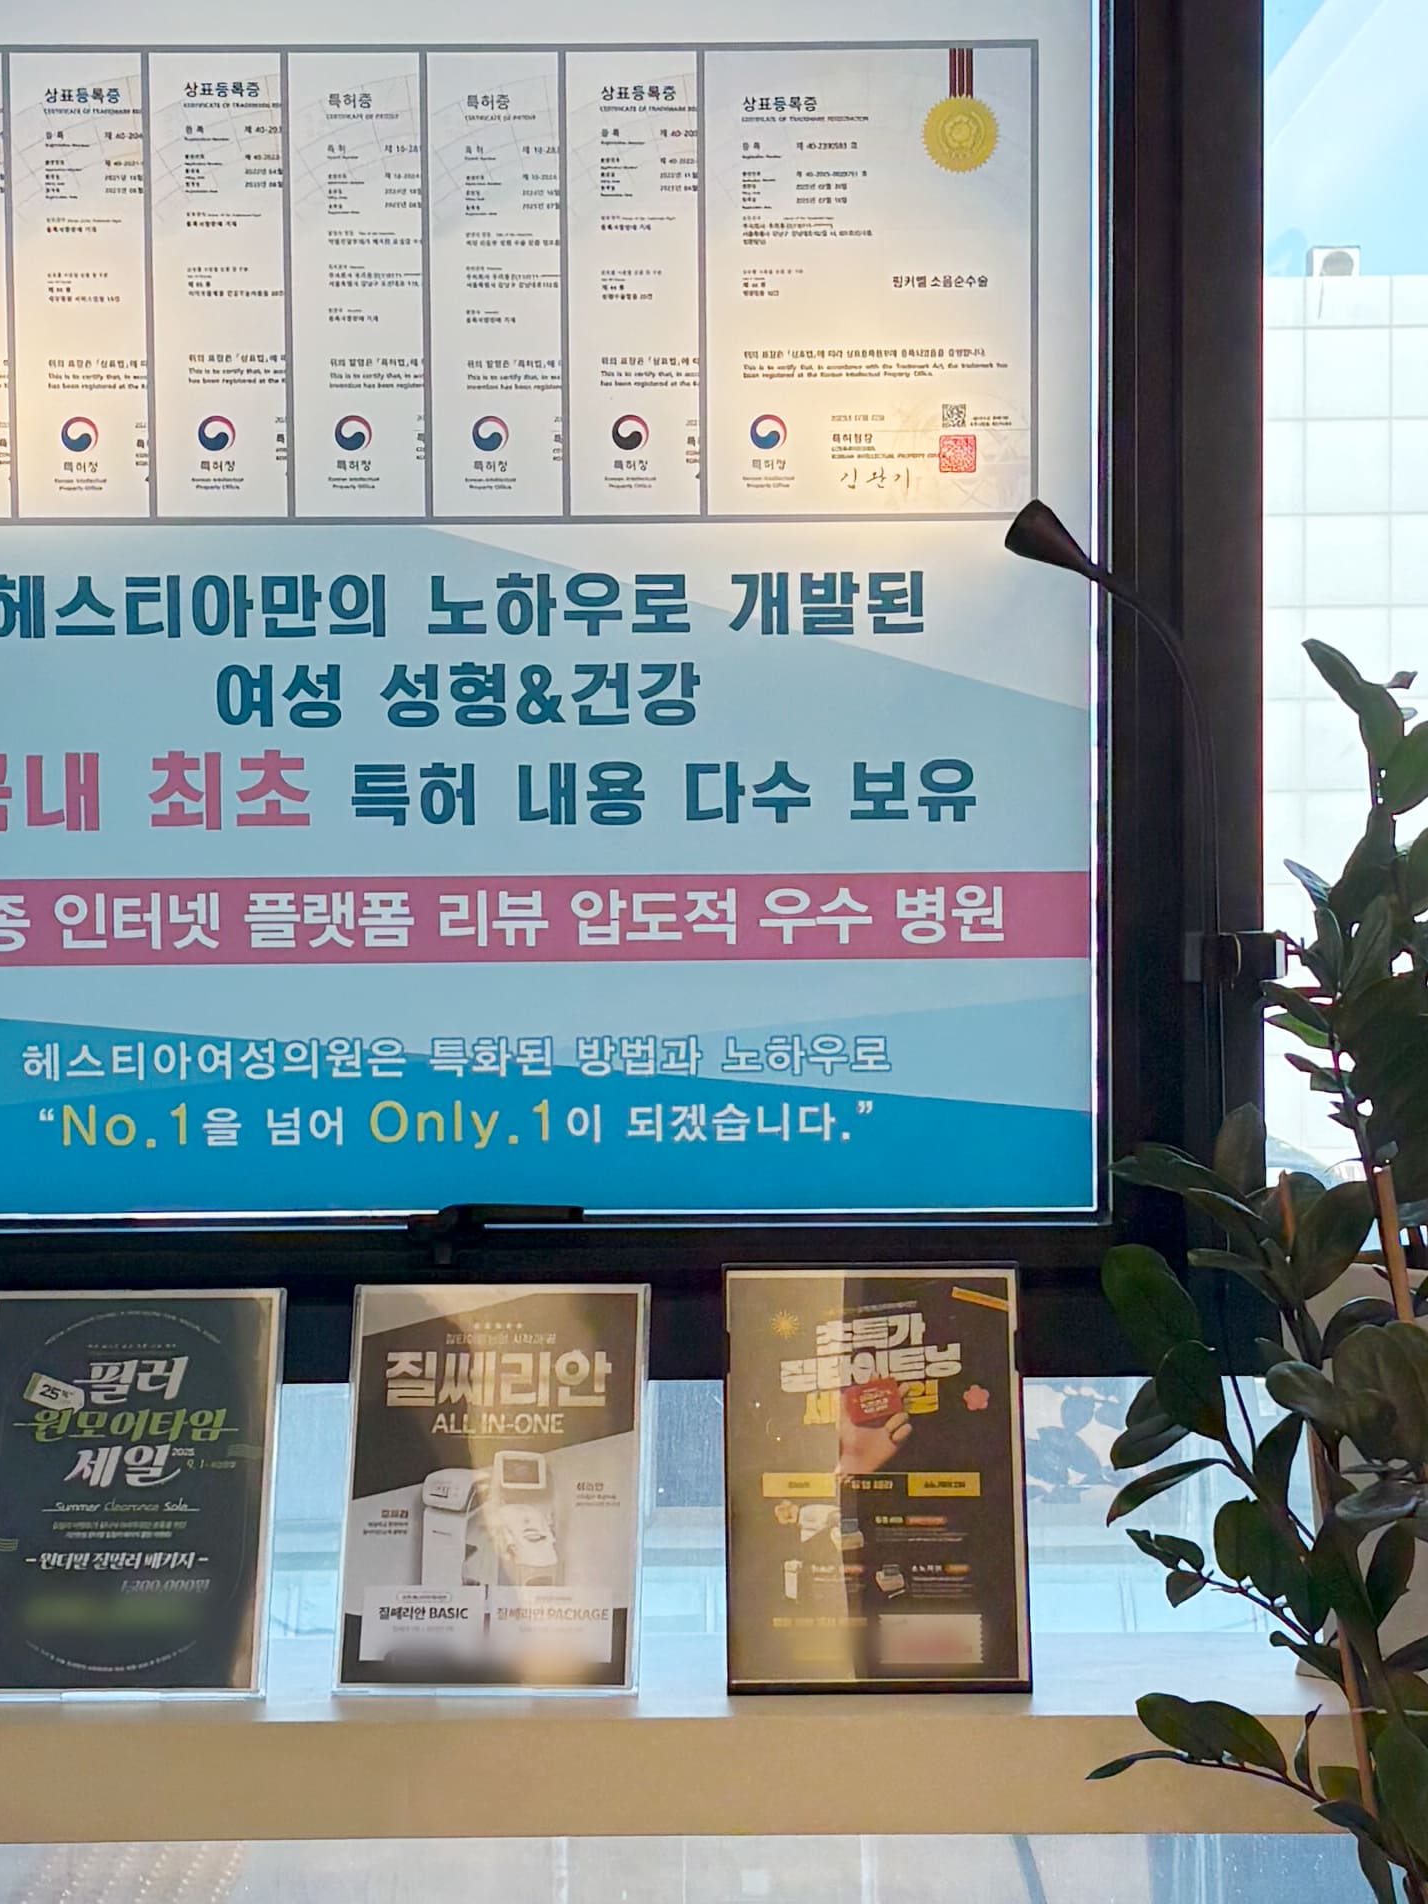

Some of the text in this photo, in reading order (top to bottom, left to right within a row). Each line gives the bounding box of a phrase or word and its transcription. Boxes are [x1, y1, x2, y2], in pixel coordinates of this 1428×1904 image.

[44, 88, 121, 104] 상표등록증
[184, 81, 260, 98] 상표등록증
[600, 84, 677, 101] 상표등록증
[328, 93, 373, 109] 특허증
[466, 94, 510, 111] 특허증
[742, 96, 818, 112] 상표등록증
[63, 461, 99, 473] 특허청
[200, 460, 236, 473] 특허청
[336, 459, 372, 472] 특허청
[473, 460, 509, 473] 특허청
[613, 459, 649, 472] 특허청
[752, 458, 787, 470] 특허청
[426, 571, 694, 641] 노하우로
[728, 571, 926, 641] 개발된
[215, 660, 702, 730] 여성 성형&건강
[147, 748, 313, 835] 최초
[350, 761, 478, 830] 특허
[517, 759, 645, 827] 내용
[684, 758, 811, 827] 다수
[848, 756, 978, 825] 보유
[53, 892, 222, 952] 인터넷
[246, 890, 416, 950] 플랫폼
[439, 889, 552, 948] 리뷰
[570, 889, 740, 947] 압도적
[758, 887, 874, 945] 우수
[893, 884, 1006, 946] 병원
[22, 1034, 892, 1081] 헤스티아여성의원은 특화된 방법과 노하우로
[37, 1098, 876, 1154] “No.1을 넘어 Only.1이 되겠습니다.”
[74, 1356, 190, 1406] 필러
[386, 1350, 613, 1408] 질쎄리안
[431, 1413, 565, 1435] ALL IN-ONE
[63, 1444, 182, 1488] 세일
[54, 1497, 190, 1513] Summer Clearance Sale
[429, 1606, 469, 1621] BASIC
[548, 1607, 610, 1621] PACKAGE
